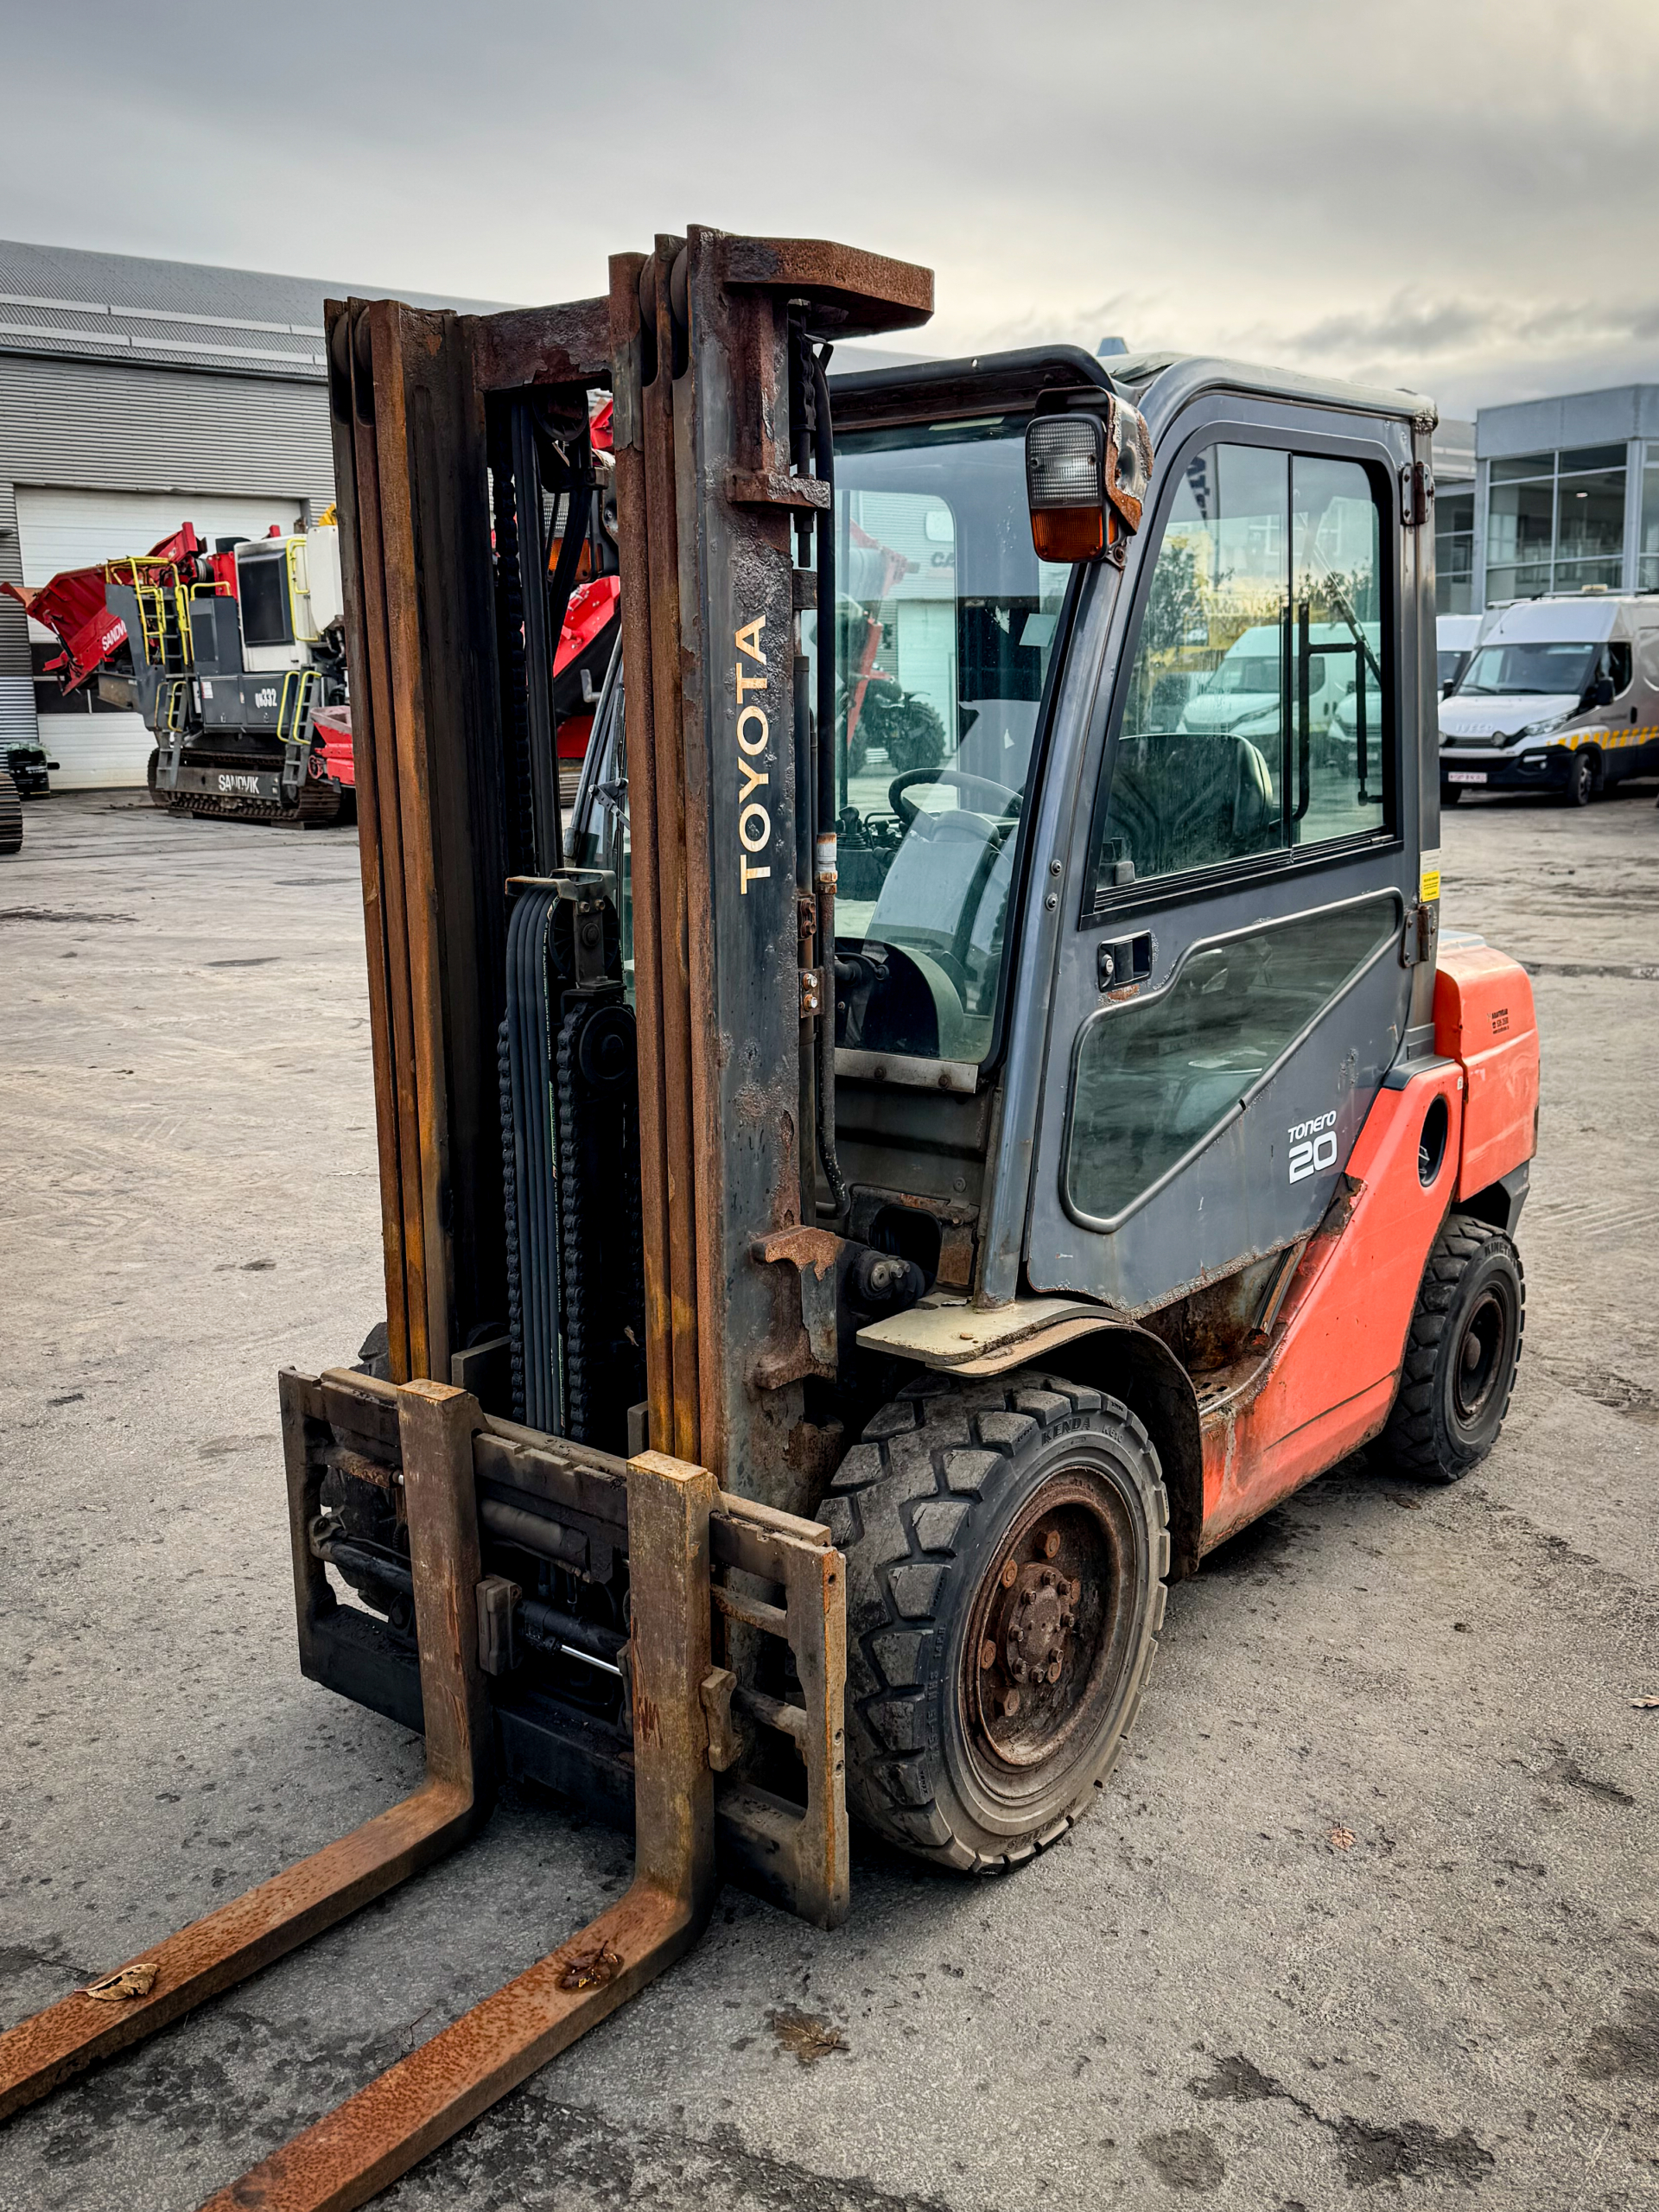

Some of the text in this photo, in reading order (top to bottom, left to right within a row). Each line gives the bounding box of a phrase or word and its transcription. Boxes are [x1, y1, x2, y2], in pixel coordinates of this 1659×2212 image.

[1455, 722, 1494, 734] IVECO
[734, 614, 772, 895] TOYOTA
[218, 774, 260, 794] SANDVIK
[1287, 1110, 1337, 1143] TONERO
[1288, 1130, 1338, 1185] 20
[1041, 1417, 1091, 1446] KENDA
